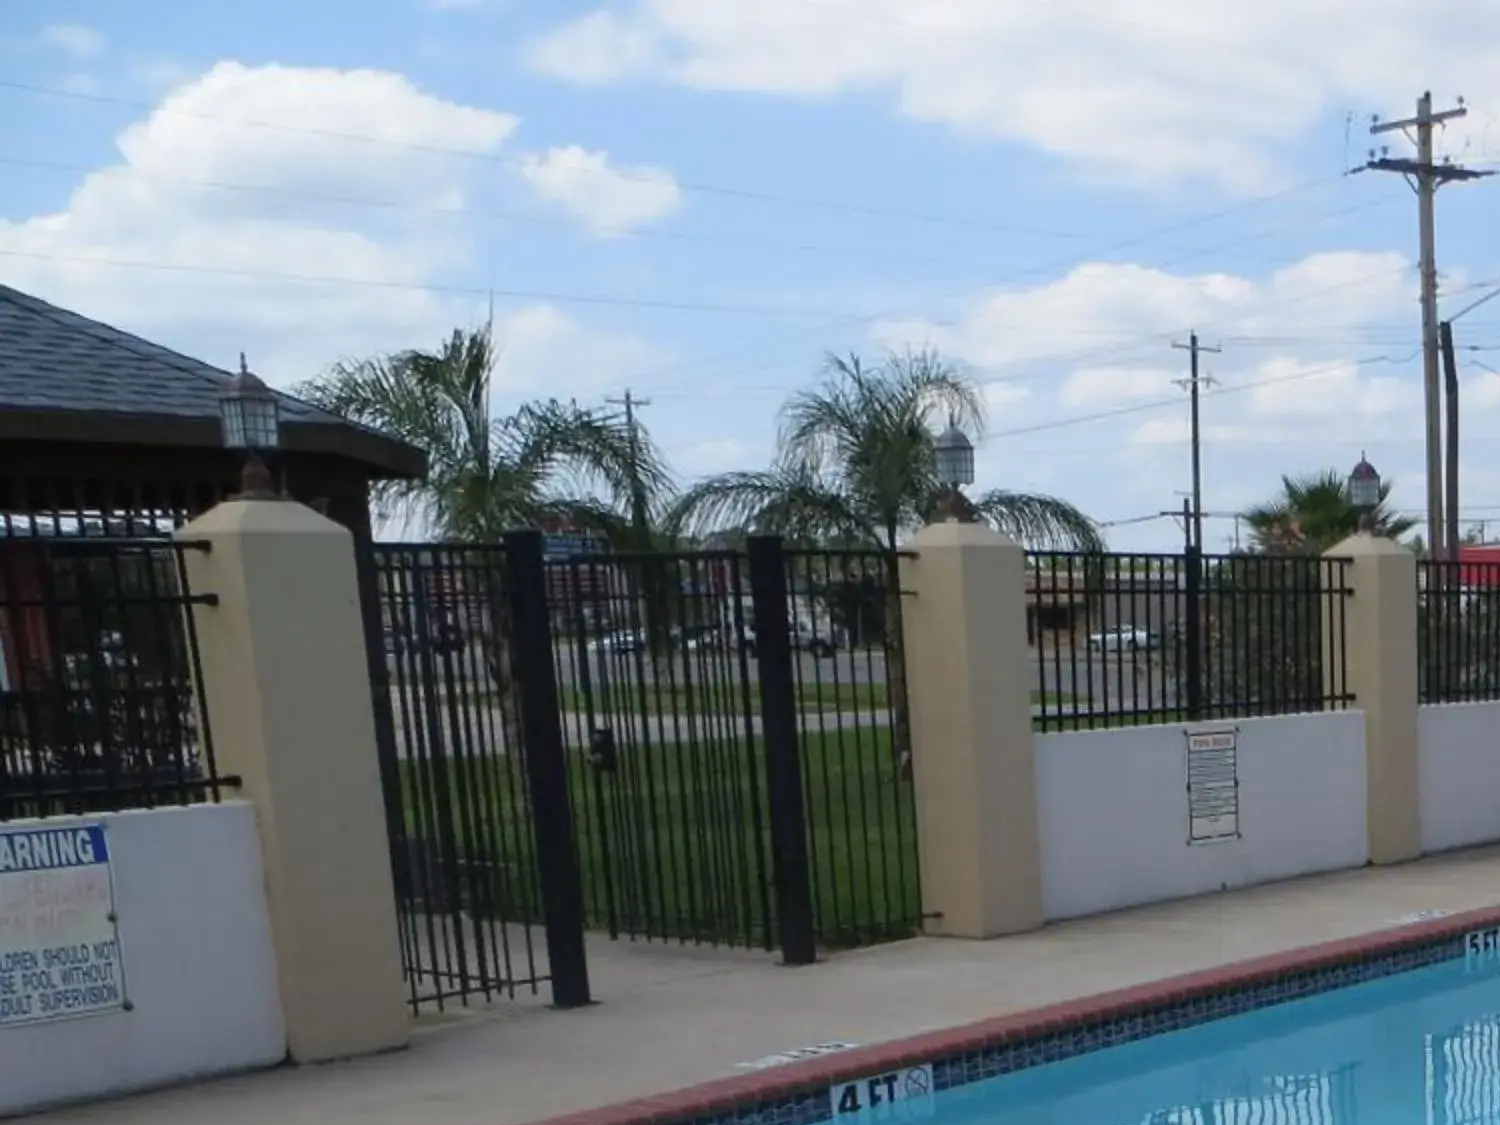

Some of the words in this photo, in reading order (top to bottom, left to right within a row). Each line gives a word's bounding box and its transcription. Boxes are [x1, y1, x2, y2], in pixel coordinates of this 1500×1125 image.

[0, 829, 95, 870] ARNING
[0, 949, 38, 974] LDREN
[43, 944, 89, 970] SHOULD
[93, 940, 116, 961] NOT
[0, 974, 17, 995] SE
[22, 970, 57, 992] POOL
[60, 961, 113, 986] WITHOUT
[0, 993, 31, 1017] DULT
[39, 983, 119, 1012] SUPERVISION
[838, 1085, 861, 1114] 4
[869, 1074, 898, 1109] FT
